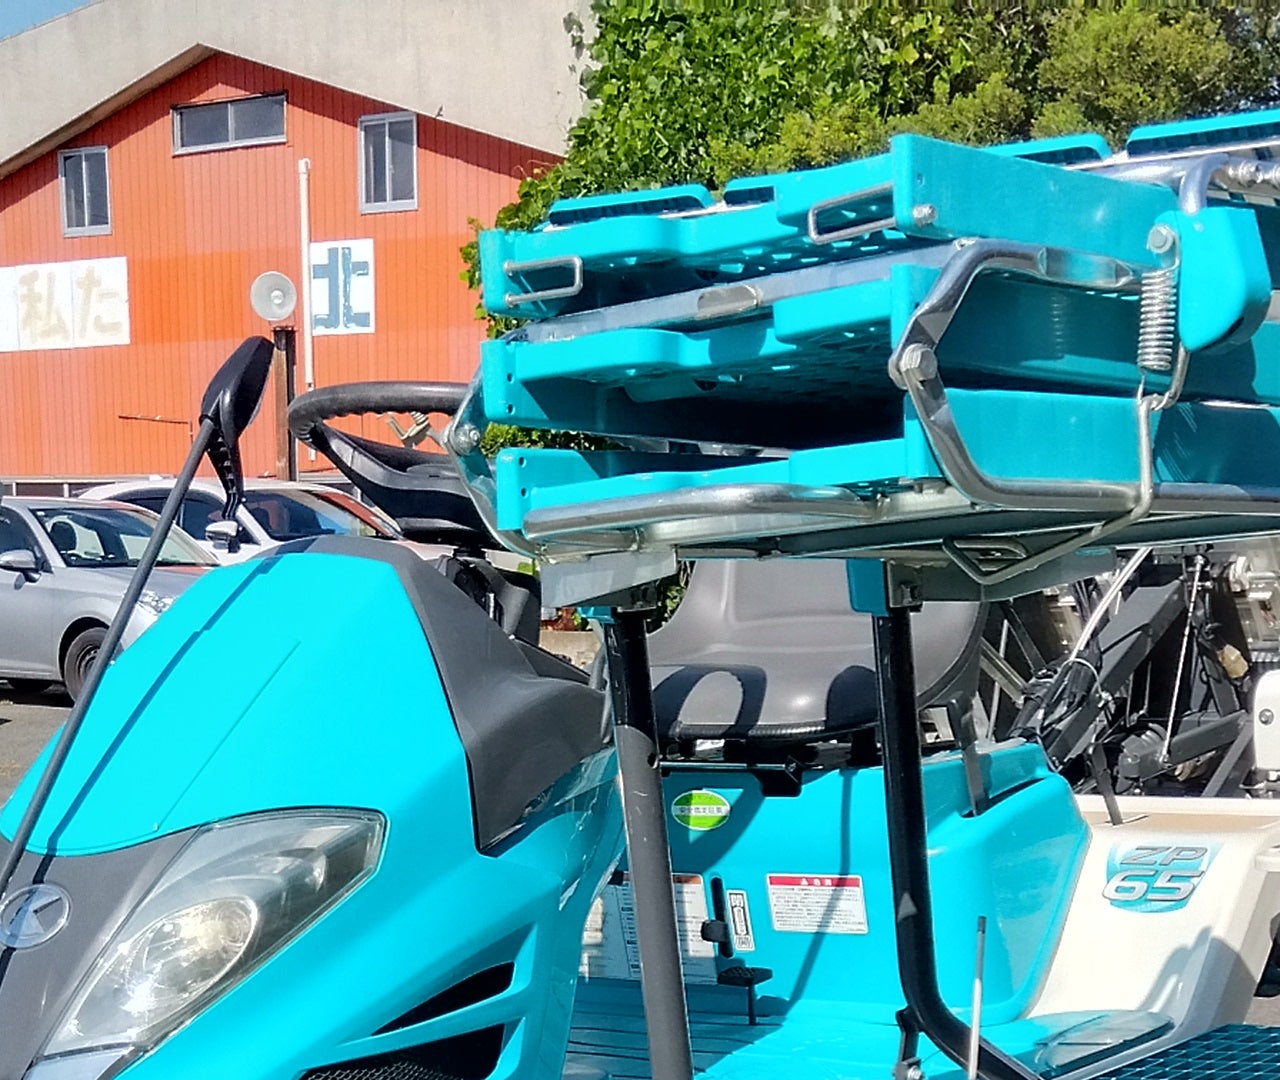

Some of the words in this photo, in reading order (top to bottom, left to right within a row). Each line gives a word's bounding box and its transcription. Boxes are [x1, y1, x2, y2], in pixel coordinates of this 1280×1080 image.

[312, 246, 371, 330] 北
[1120, 845, 1208, 866] ZP
[1102, 868, 1205, 902] 65
